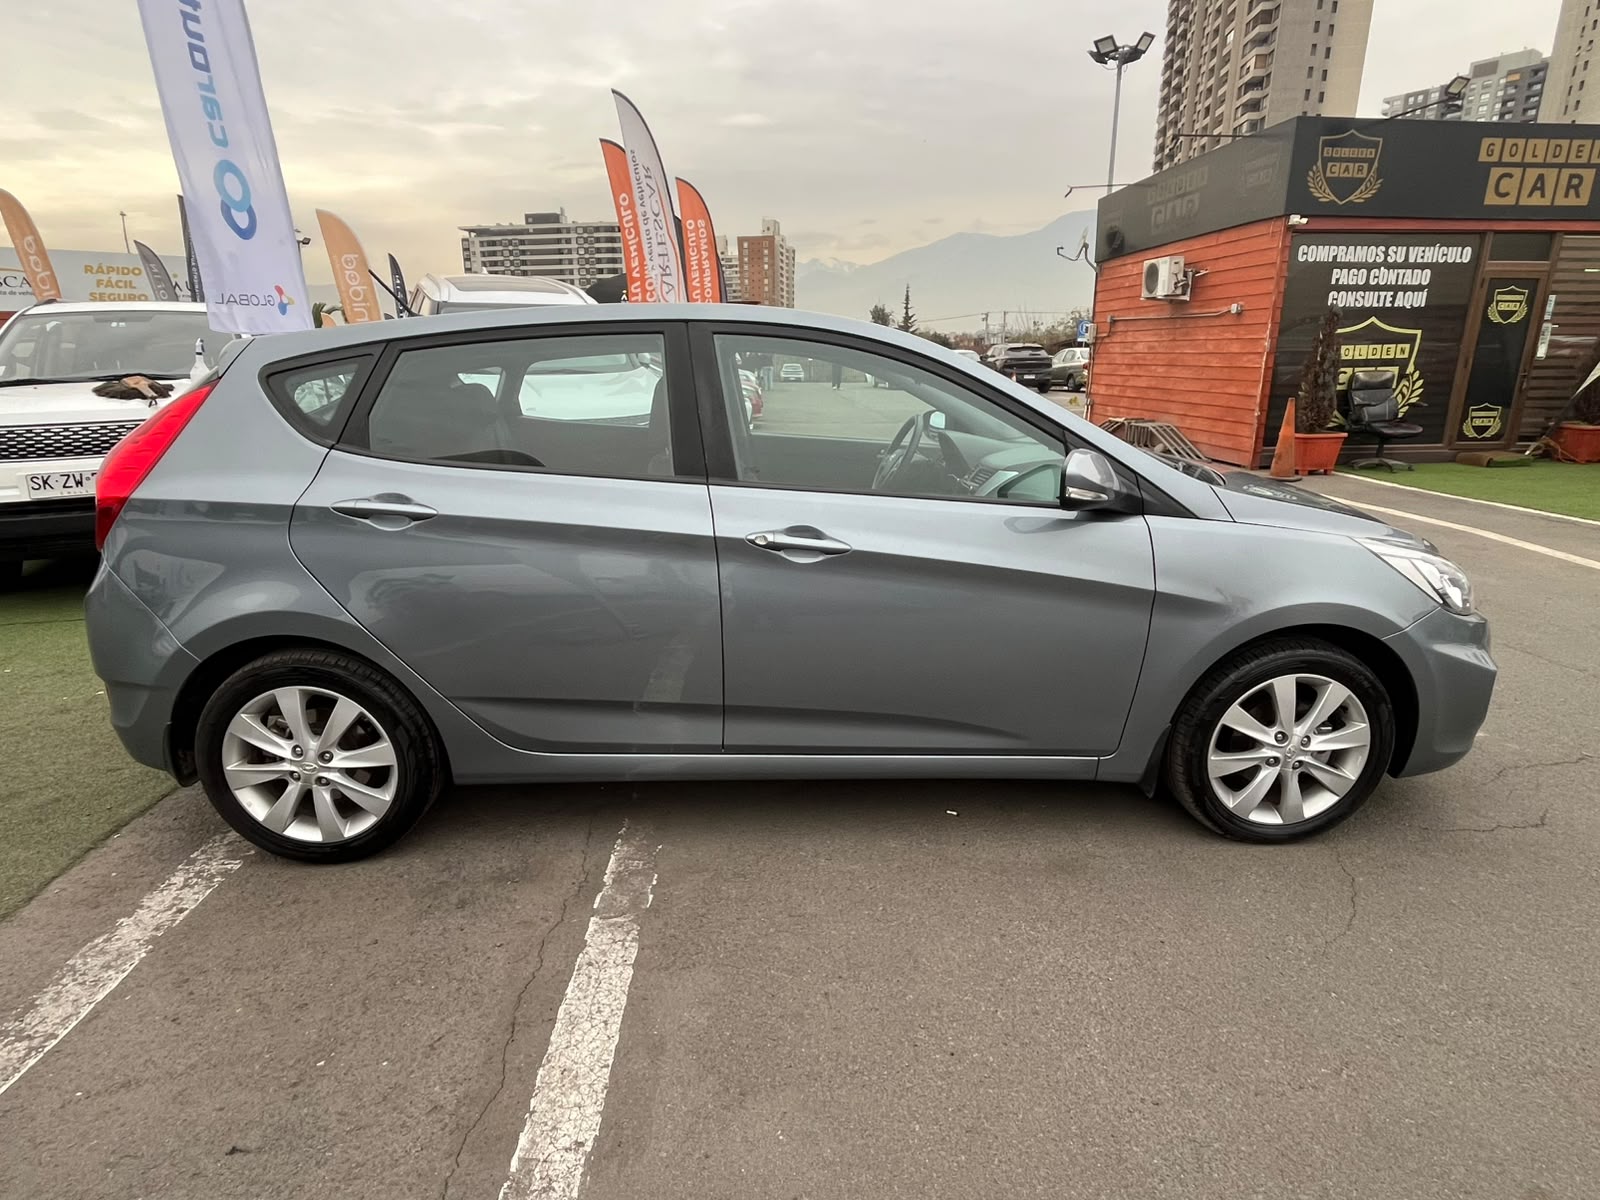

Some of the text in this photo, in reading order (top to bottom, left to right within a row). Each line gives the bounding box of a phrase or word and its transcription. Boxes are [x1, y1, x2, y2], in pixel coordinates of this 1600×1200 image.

[1329, 163, 1365, 176] CAR
[1492, 171, 1586, 200] CAR
[1297, 243, 1473, 263] COMPRAMOS SU VEHÍCULO
[84, 262, 143, 276] RÁPIDO
[1331, 267, 1432, 285] PAGO CONTADO
[95, 276, 137, 289] FÁCIL
[88, 291, 149, 302] SEGURO
[1328, 289, 1429, 309] CONSULTE AQUÍ
[1343, 346, 1407, 358] OLDEN
